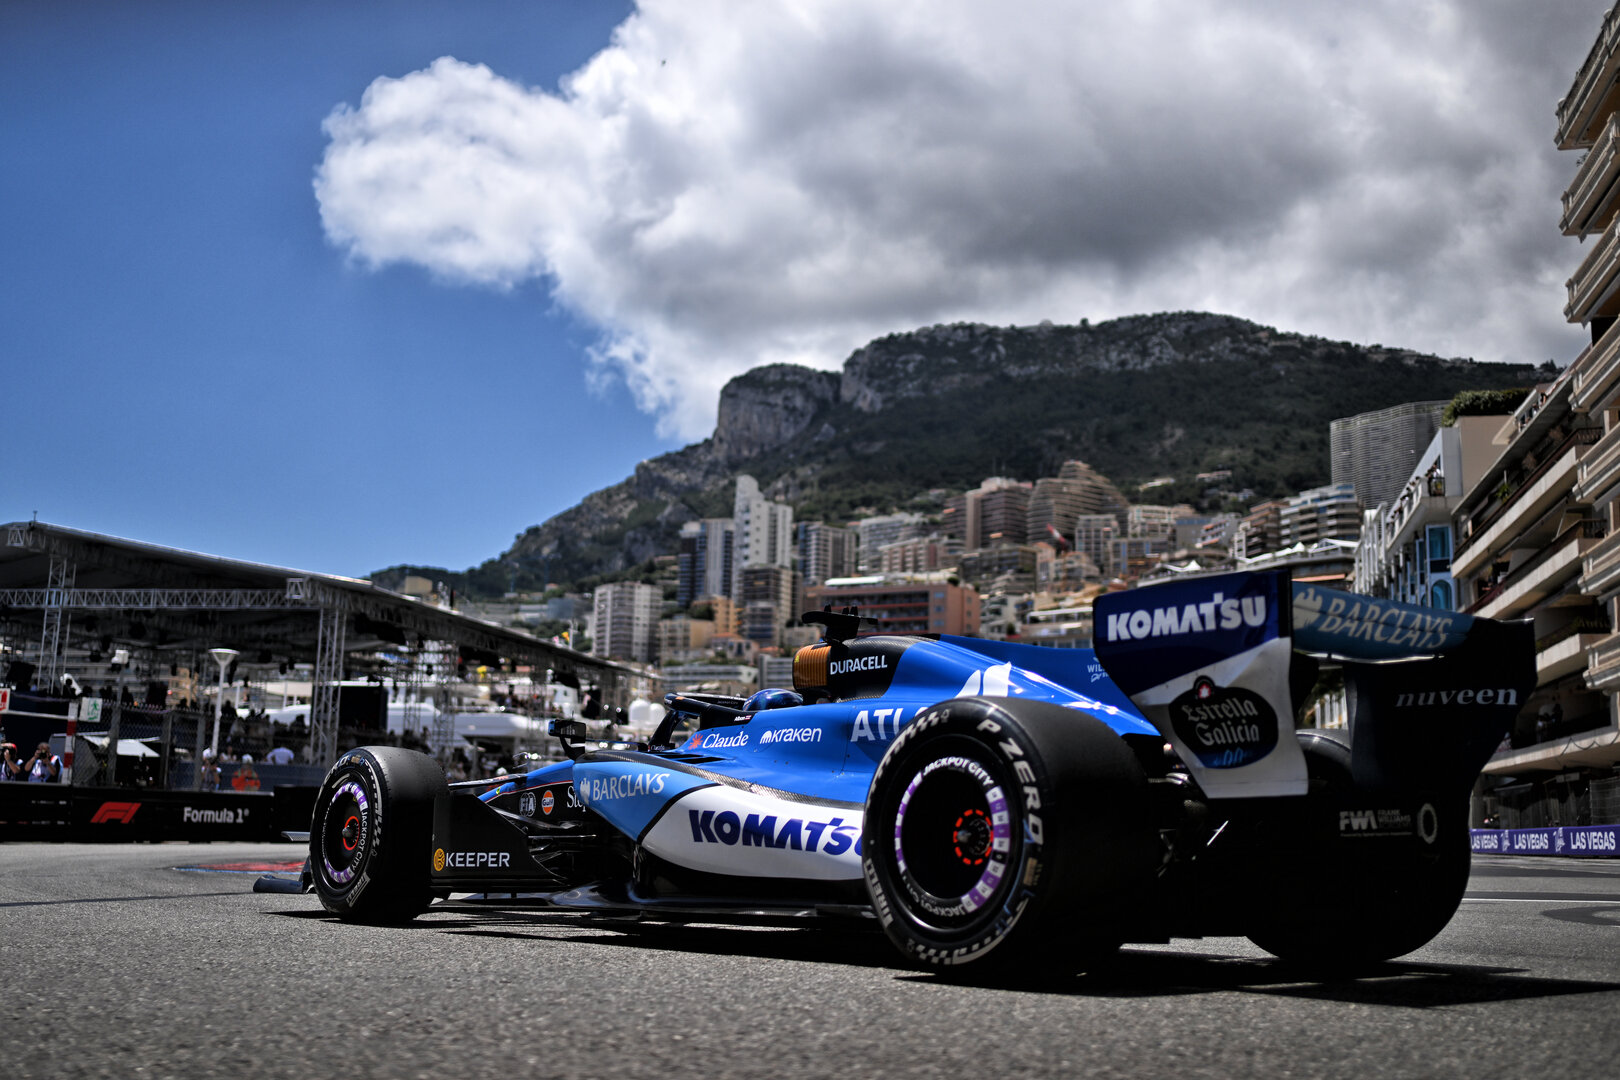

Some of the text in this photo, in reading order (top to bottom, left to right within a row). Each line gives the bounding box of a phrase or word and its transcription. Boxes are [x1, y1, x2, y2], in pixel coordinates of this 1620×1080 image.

[1107, 591, 1266, 642] KOMATSU
[1318, 597, 1453, 650] BARCLAYS
[829, 654, 888, 676] DURACELL
[1087, 663, 1105, 674] WIL
[1393, 687, 1519, 708] nuveen
[1181, 697, 1259, 722] Estrella
[702, 730, 749, 749] Claude
[1194, 719, 1260, 747] Galicia
[922, 756, 994, 787] JACKPOT CITY
[976, 718, 1002, 734] P
[998, 737, 1045, 846] ZERO
[592, 773, 670, 801] BARCLAYS
[183, 806, 234, 824] Formula
[351, 810, 369, 871] JACKPOT CITY
[1480, 834, 1499, 849] VEGAS
[1514, 833, 1528, 849] LAS
[1527, 833, 1549, 849] VEGAS
[1571, 832, 1587, 850] LAS
[1586, 831, 1616, 850] VEGAS
[445, 852, 511, 868] KEEPER
[919, 899, 967, 918] JACKPOT
